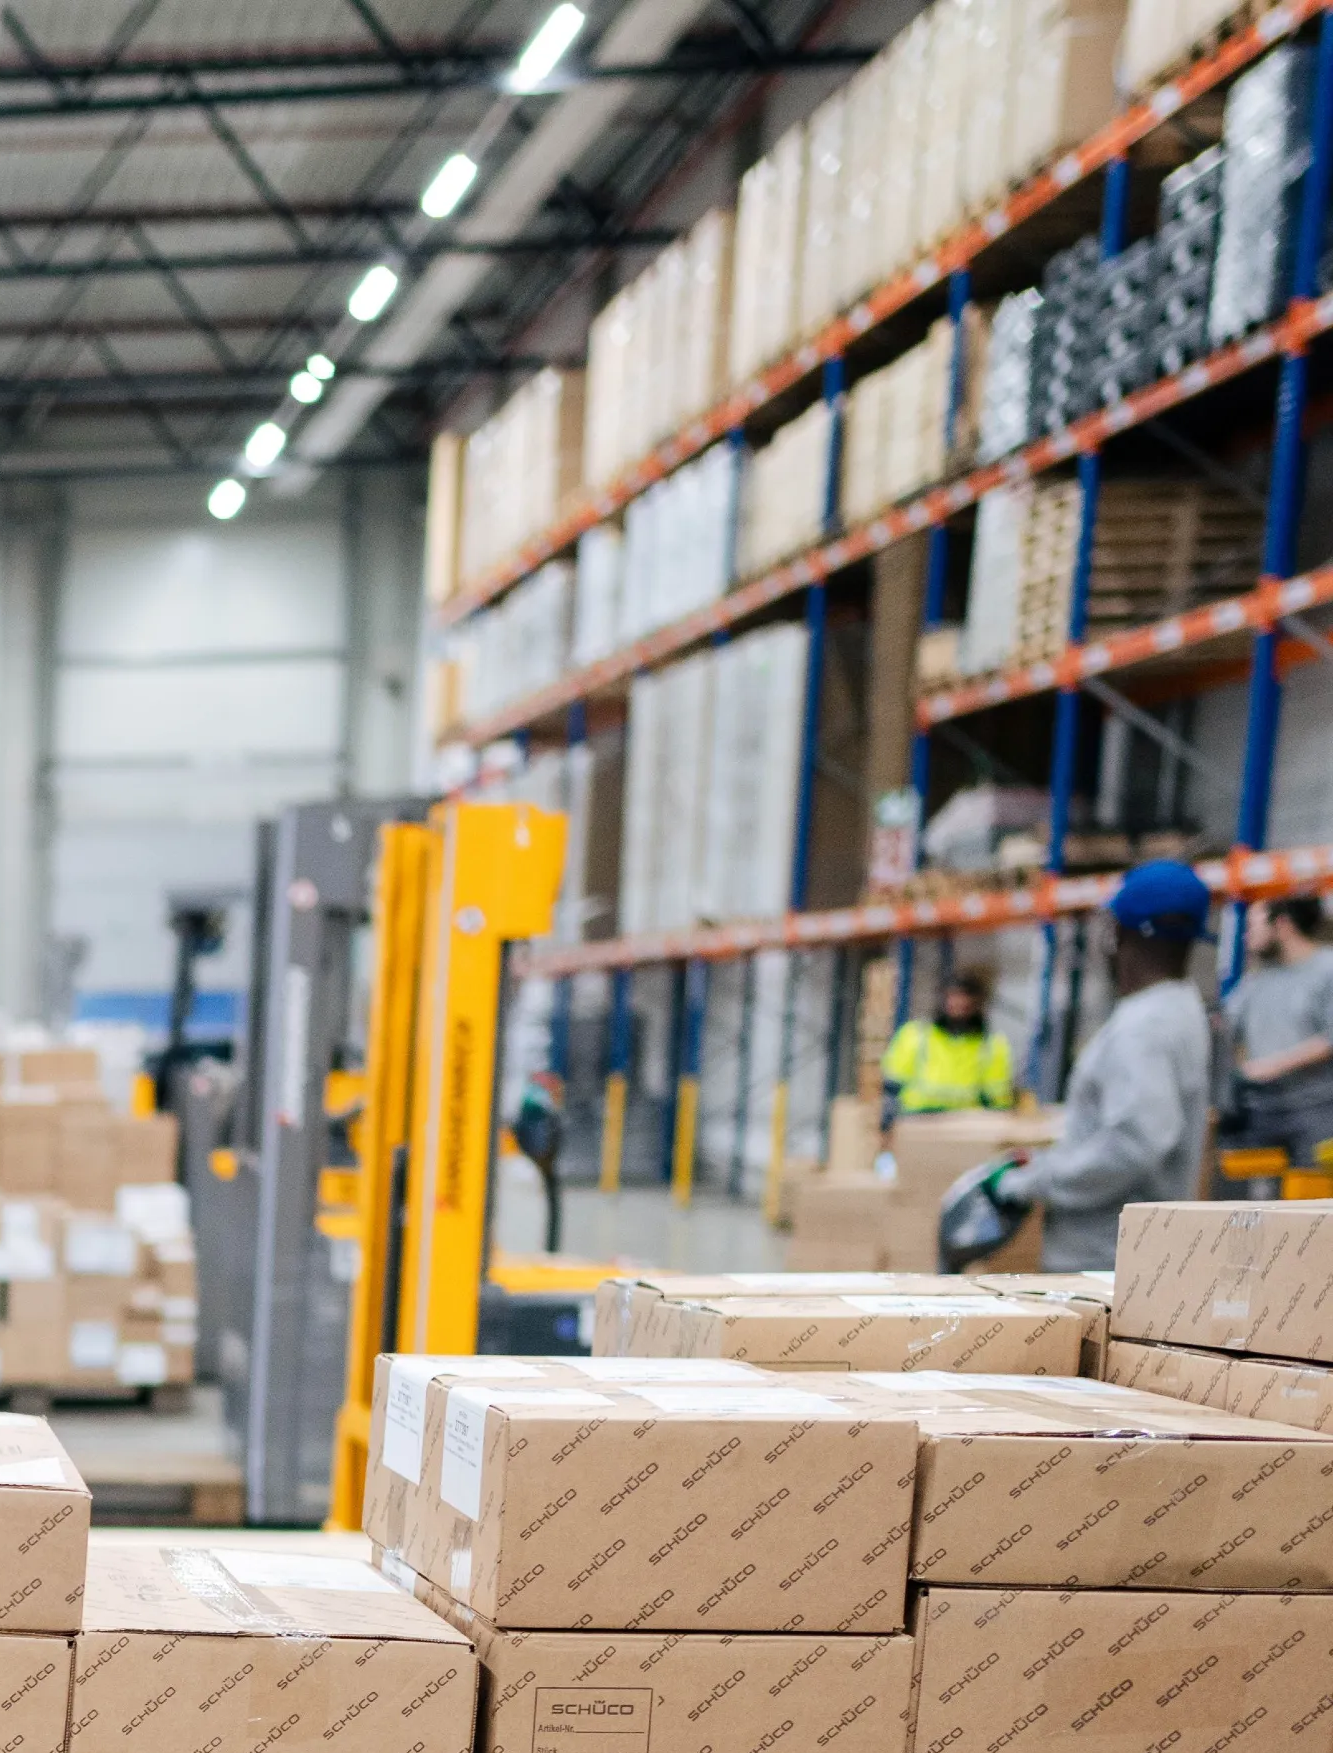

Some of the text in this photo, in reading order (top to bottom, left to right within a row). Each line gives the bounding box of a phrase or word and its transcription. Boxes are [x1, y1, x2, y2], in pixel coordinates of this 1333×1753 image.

[1177, 1230, 1203, 1278] SCHÜCO
[814, 1462, 873, 1514] SCHÜCO
[1232, 1449, 1295, 1501] SCHÜCO
[17, 1504, 74, 1555] SCHÜCO
[520, 1489, 576, 1540] SCHÜCO
[1056, 1500, 1119, 1550] SCHÜCO
[970, 1525, 1032, 1575] SCHÜCO
[1108, 1604, 1169, 1656] SCHÜCO
[1, 1664, 55, 1711] SCHÜCO
[199, 1664, 253, 1712] SCHÜCO
[402, 1669, 457, 1717] SCHÜCO
[769, 1645, 827, 1697] SCHÜCO
[939, 1653, 999, 1703] SCHÜCO
[537, 1724, 575, 1733] Artikel-Nr.
[551, 1700, 634, 1715] SCHÜCO
